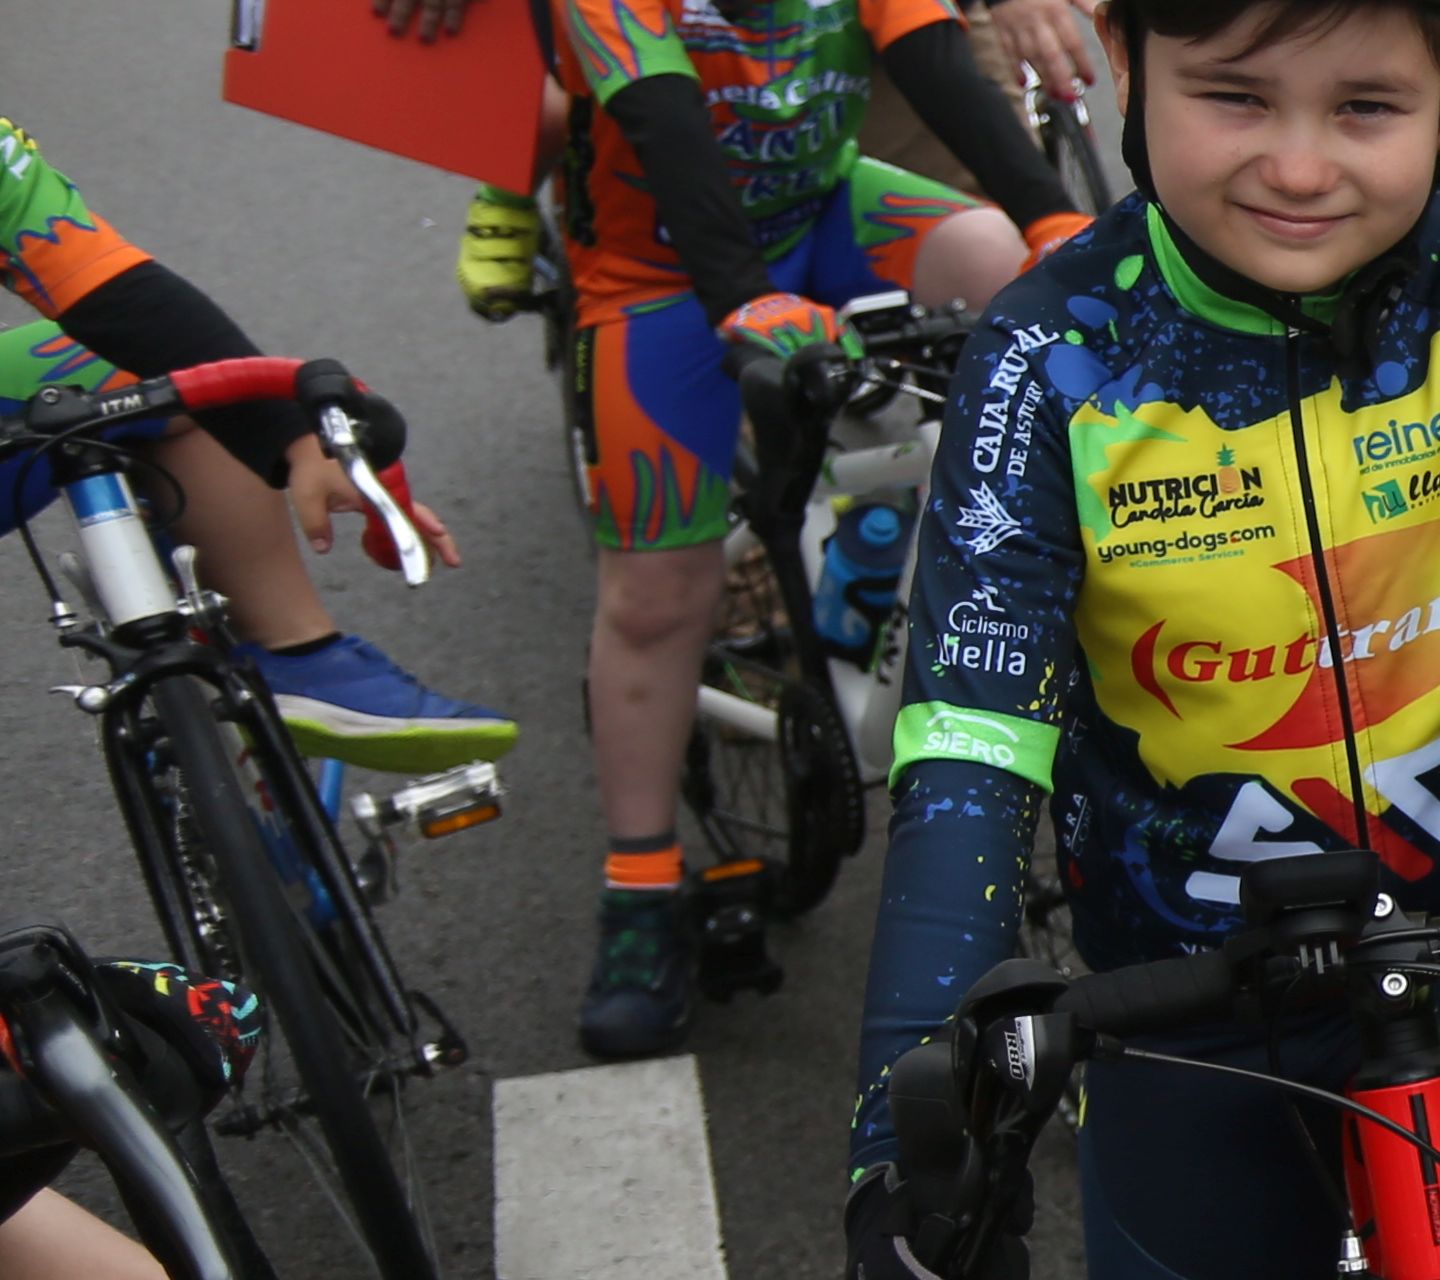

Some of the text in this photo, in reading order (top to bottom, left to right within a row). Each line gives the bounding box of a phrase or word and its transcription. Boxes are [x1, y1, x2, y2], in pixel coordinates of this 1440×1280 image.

[100, 393, 144, 415] ITM
[972, 397, 1010, 474] CAJA
[1006, 449, 1027, 478] DE
[1098, 523, 1277, 563] young-dogs.com
[948, 600, 1029, 642] Ciclismo
